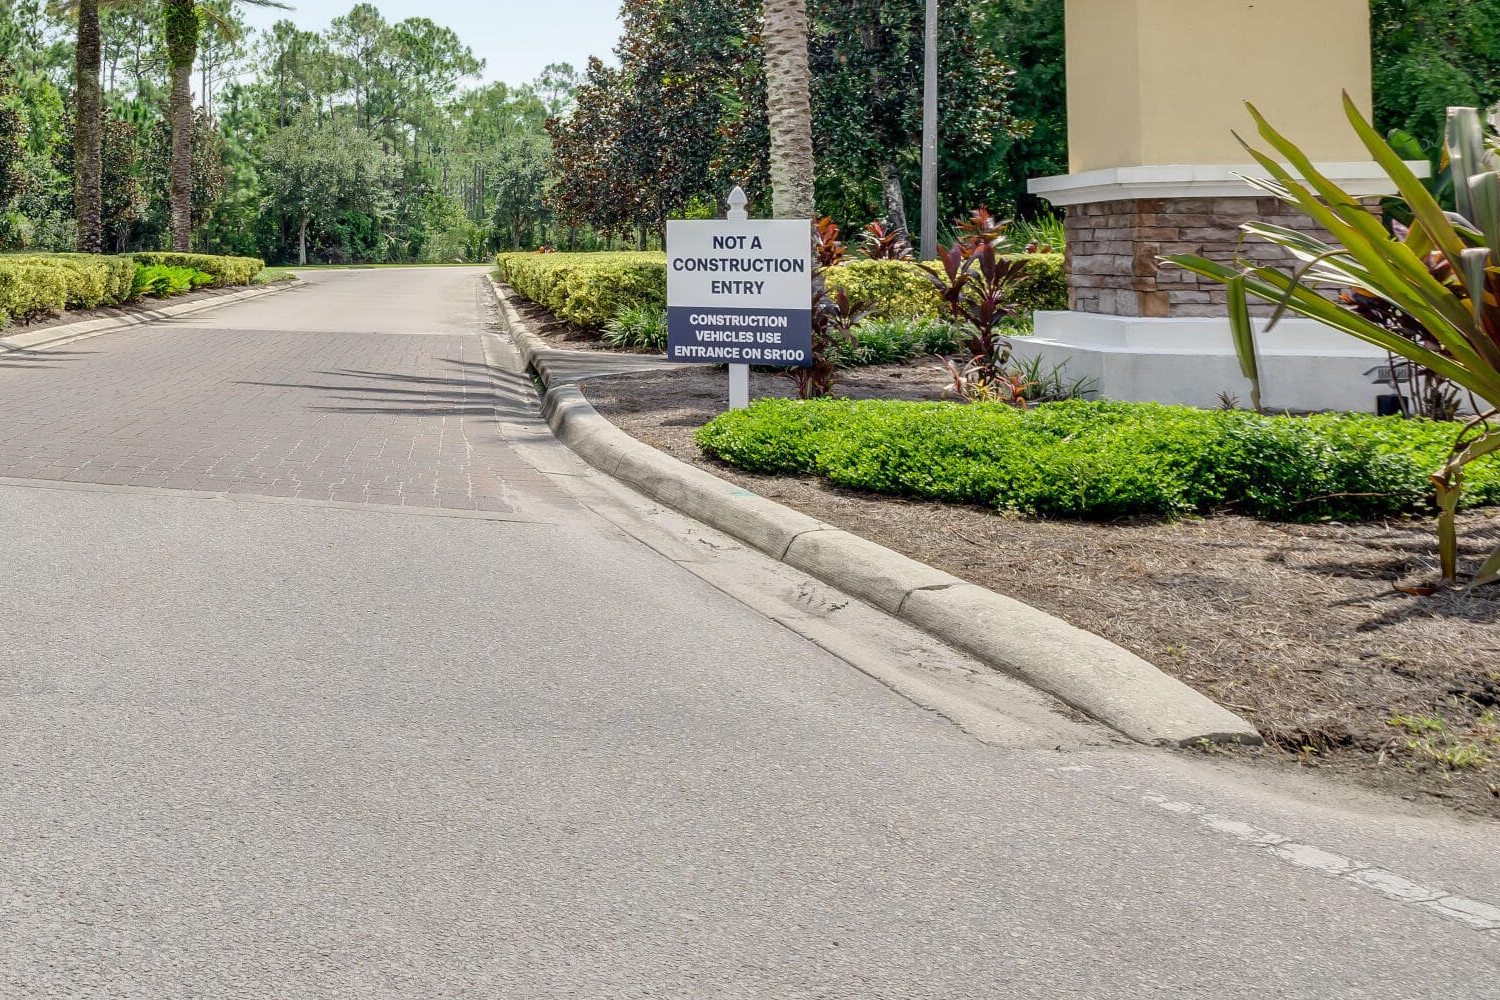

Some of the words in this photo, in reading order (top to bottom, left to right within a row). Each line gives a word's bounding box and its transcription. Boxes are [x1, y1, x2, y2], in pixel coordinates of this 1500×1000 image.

[712, 236, 746, 250] NOT
[750, 236, 762, 250] A
[672, 258, 804, 273] CONSTRUCTION
[711, 280, 764, 295] ENTRY
[689, 314, 788, 328] CONSTRUCTION
[695, 330, 754, 343] VEHICLES
[756, 332, 782, 344] USE
[674, 345, 740, 359] ENTRANCE
[742, 347, 761, 360] ON
[763, 349, 805, 362] SR100
